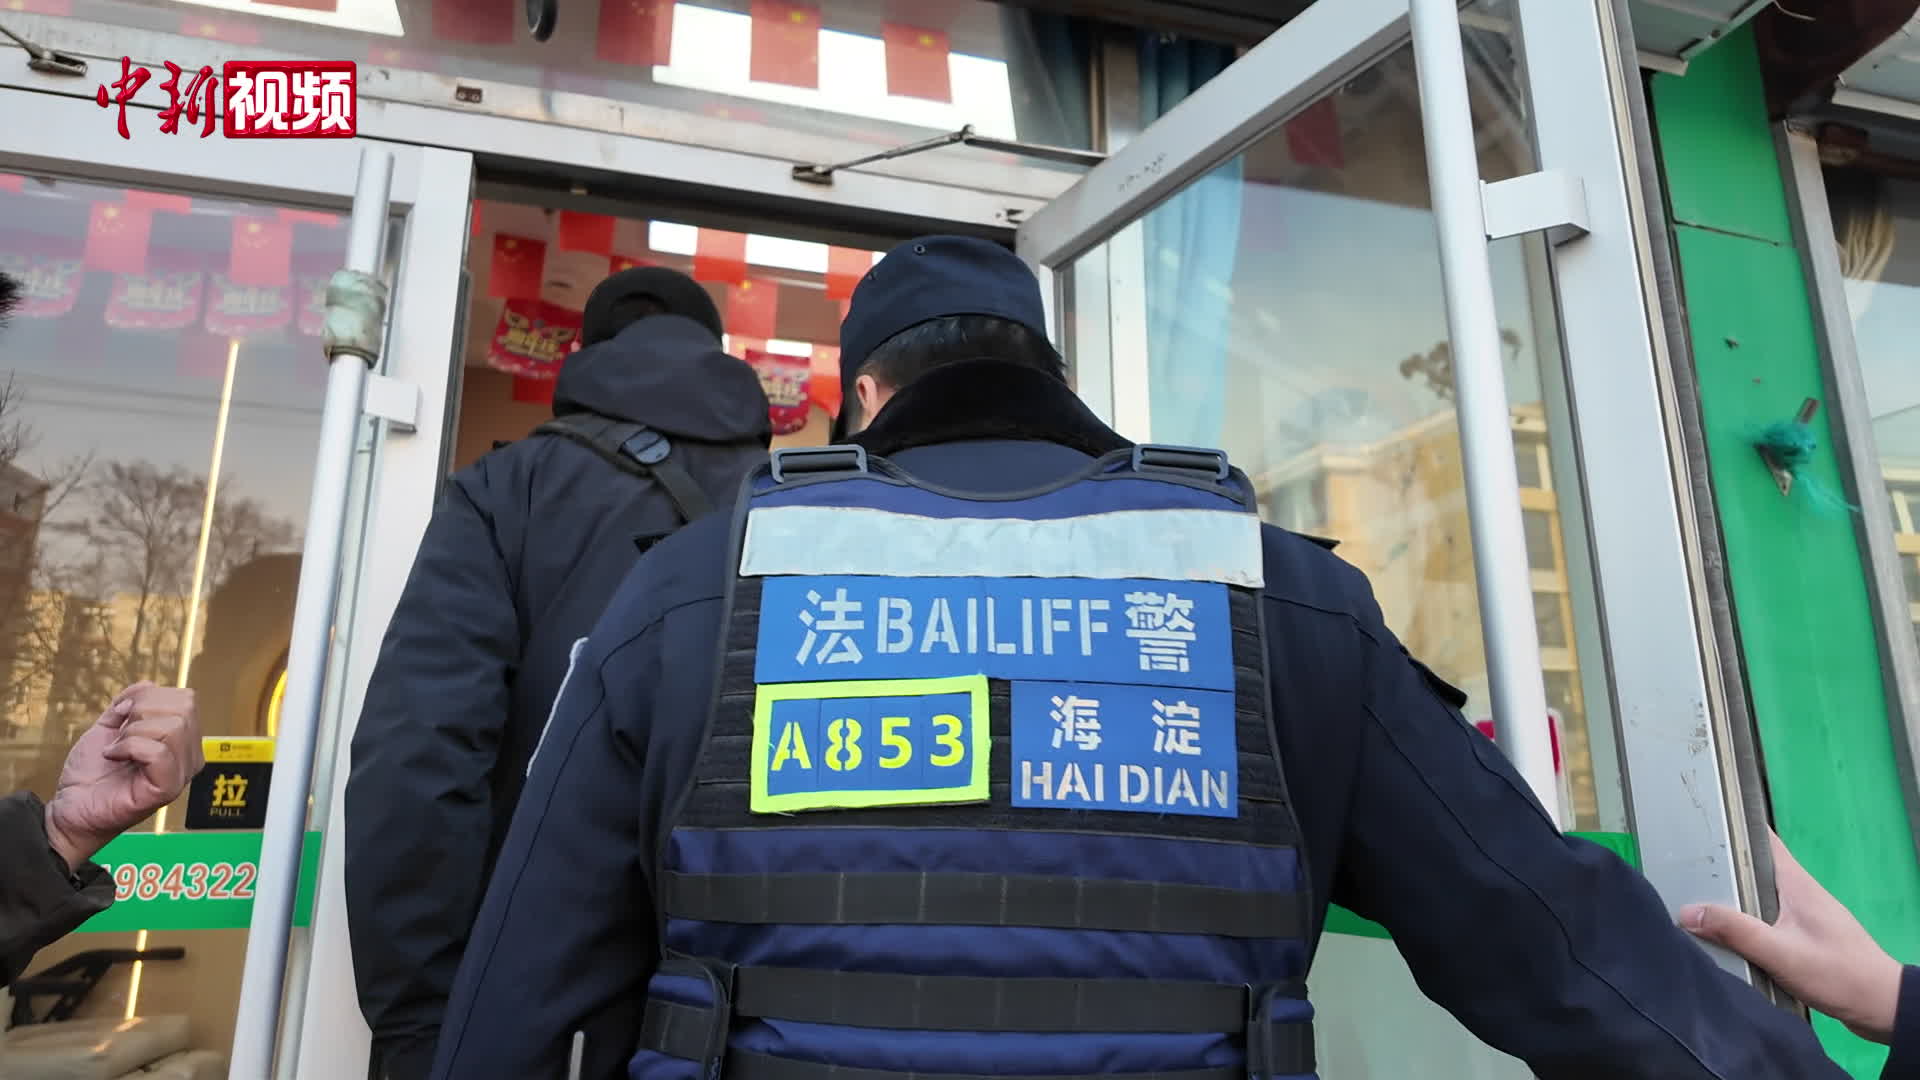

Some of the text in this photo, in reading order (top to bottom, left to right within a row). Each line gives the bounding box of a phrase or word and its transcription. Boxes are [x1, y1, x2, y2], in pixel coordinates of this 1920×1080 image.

[770, 714, 965, 771] A853
[212, 774, 248, 807] 拉
[209, 807, 243, 817] PULL
[101, 862, 257, 901] 984322
